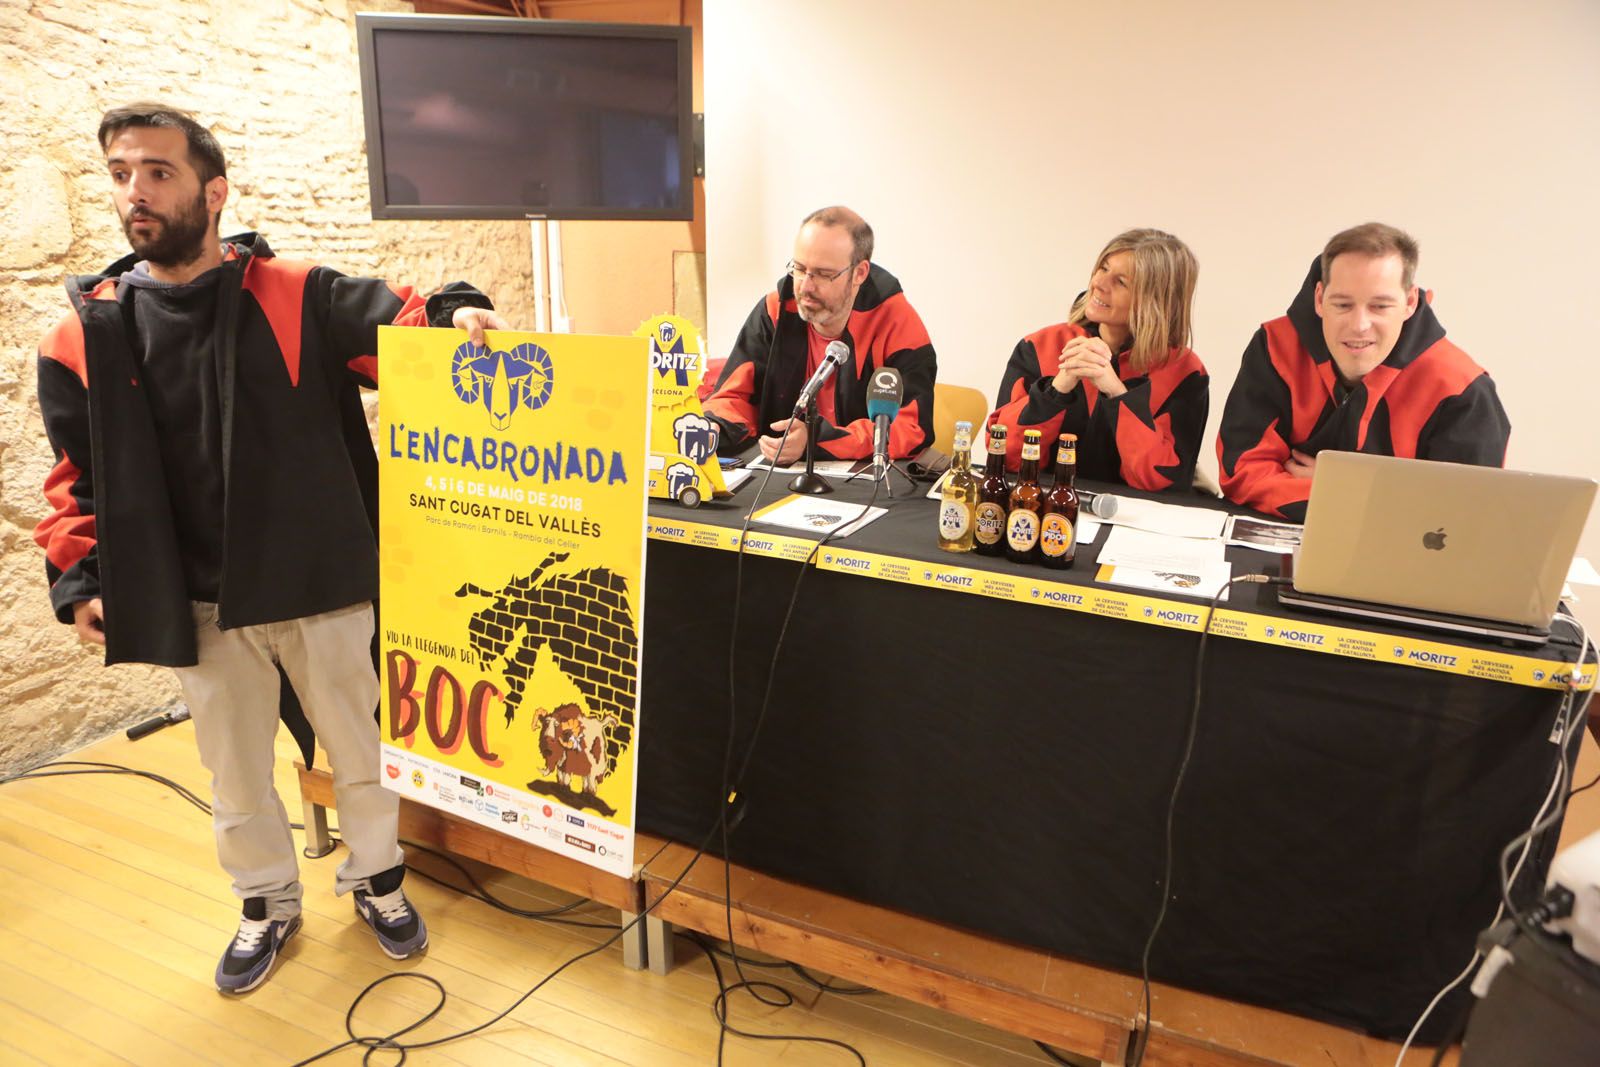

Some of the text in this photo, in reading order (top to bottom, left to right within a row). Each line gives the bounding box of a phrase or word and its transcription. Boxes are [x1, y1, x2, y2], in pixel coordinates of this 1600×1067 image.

[653, 352, 699, 370] ORITZ
[390, 424, 628, 485] L'ENCABRONADA
[425, 476, 436, 491] 4,
[440, 477, 447, 491] 5
[457, 480, 464, 493] 6
[468, 481, 486, 497] DE
[488, 484, 524, 502] MAIG
[528, 491, 547, 506] DE
[550, 494, 583, 512] 2018
[410, 493, 601, 538] SANT CUGAT DEL VALLÈS
[426, 515, 441, 525] Parc
[482, 525, 507, 536] Barnils
[513, 530, 542, 543] Rambla
[544, 536, 555, 545] del
[557, 539, 580, 549] Celler
[655, 526, 685, 537] MORITZ
[743, 540, 774, 550] MORITZ
[836, 557, 870, 570] MORITZ
[936, 573, 972, 586] MORITZ
[1044, 592, 1083, 604] MORITZ
[1157, 610, 1199, 624] MORITZ
[386, 630, 399, 644] VIU
[402, 633, 412, 648] LA
[416, 638, 456, 659] LLEGENDA
[1279, 630, 1324, 645] MORITZ
[1409, 650, 1457, 666] MORITZ
[1481, 660, 1514, 670] CERVESERA
[386, 649, 504, 768] BOC
